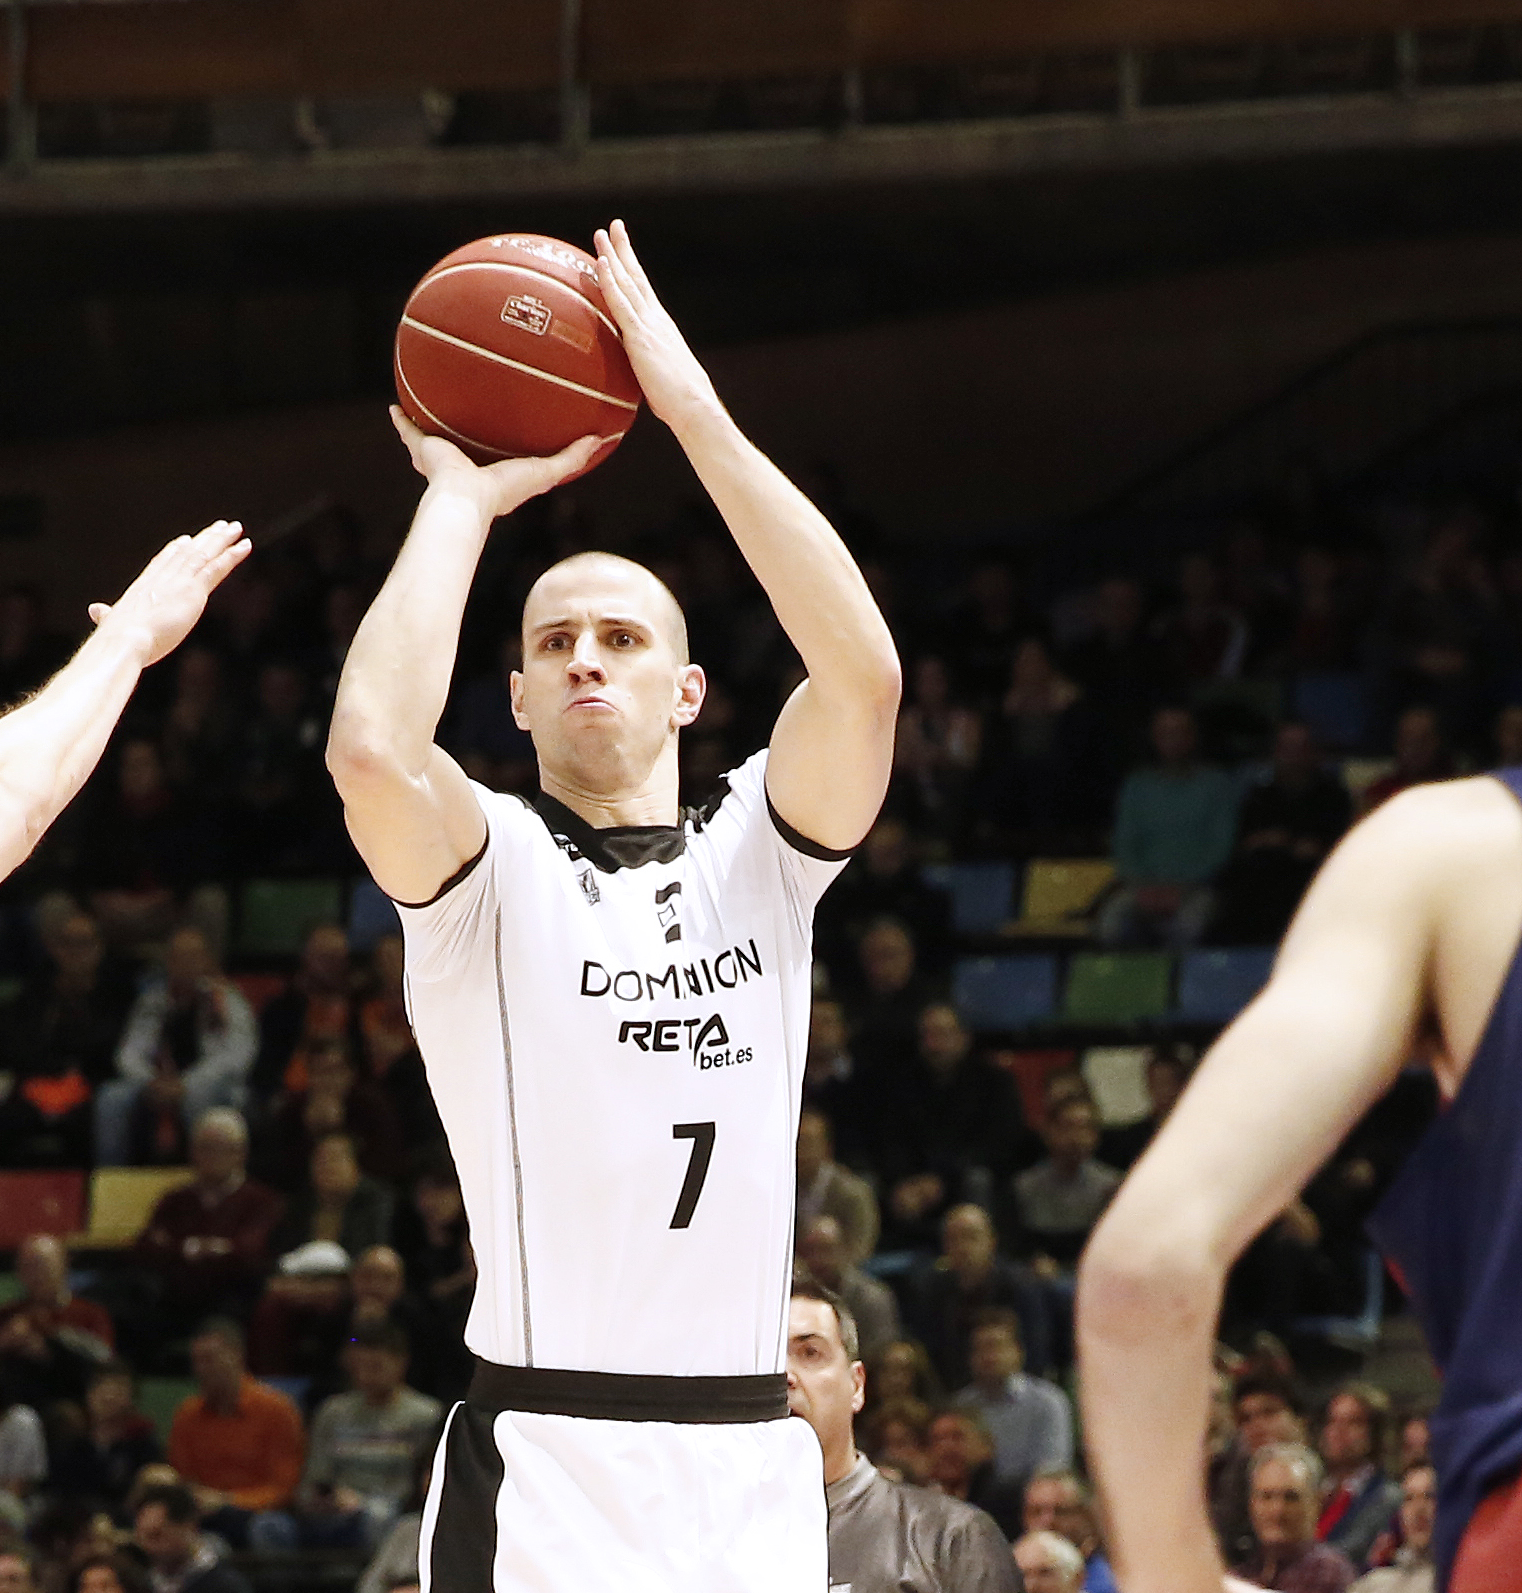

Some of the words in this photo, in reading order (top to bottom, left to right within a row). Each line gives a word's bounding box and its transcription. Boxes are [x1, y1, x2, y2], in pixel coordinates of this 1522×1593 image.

[618, 1013, 729, 1066] RETA
[700, 1047, 753, 1070] bet.es
[668, 1120, 717, 1230] 7
